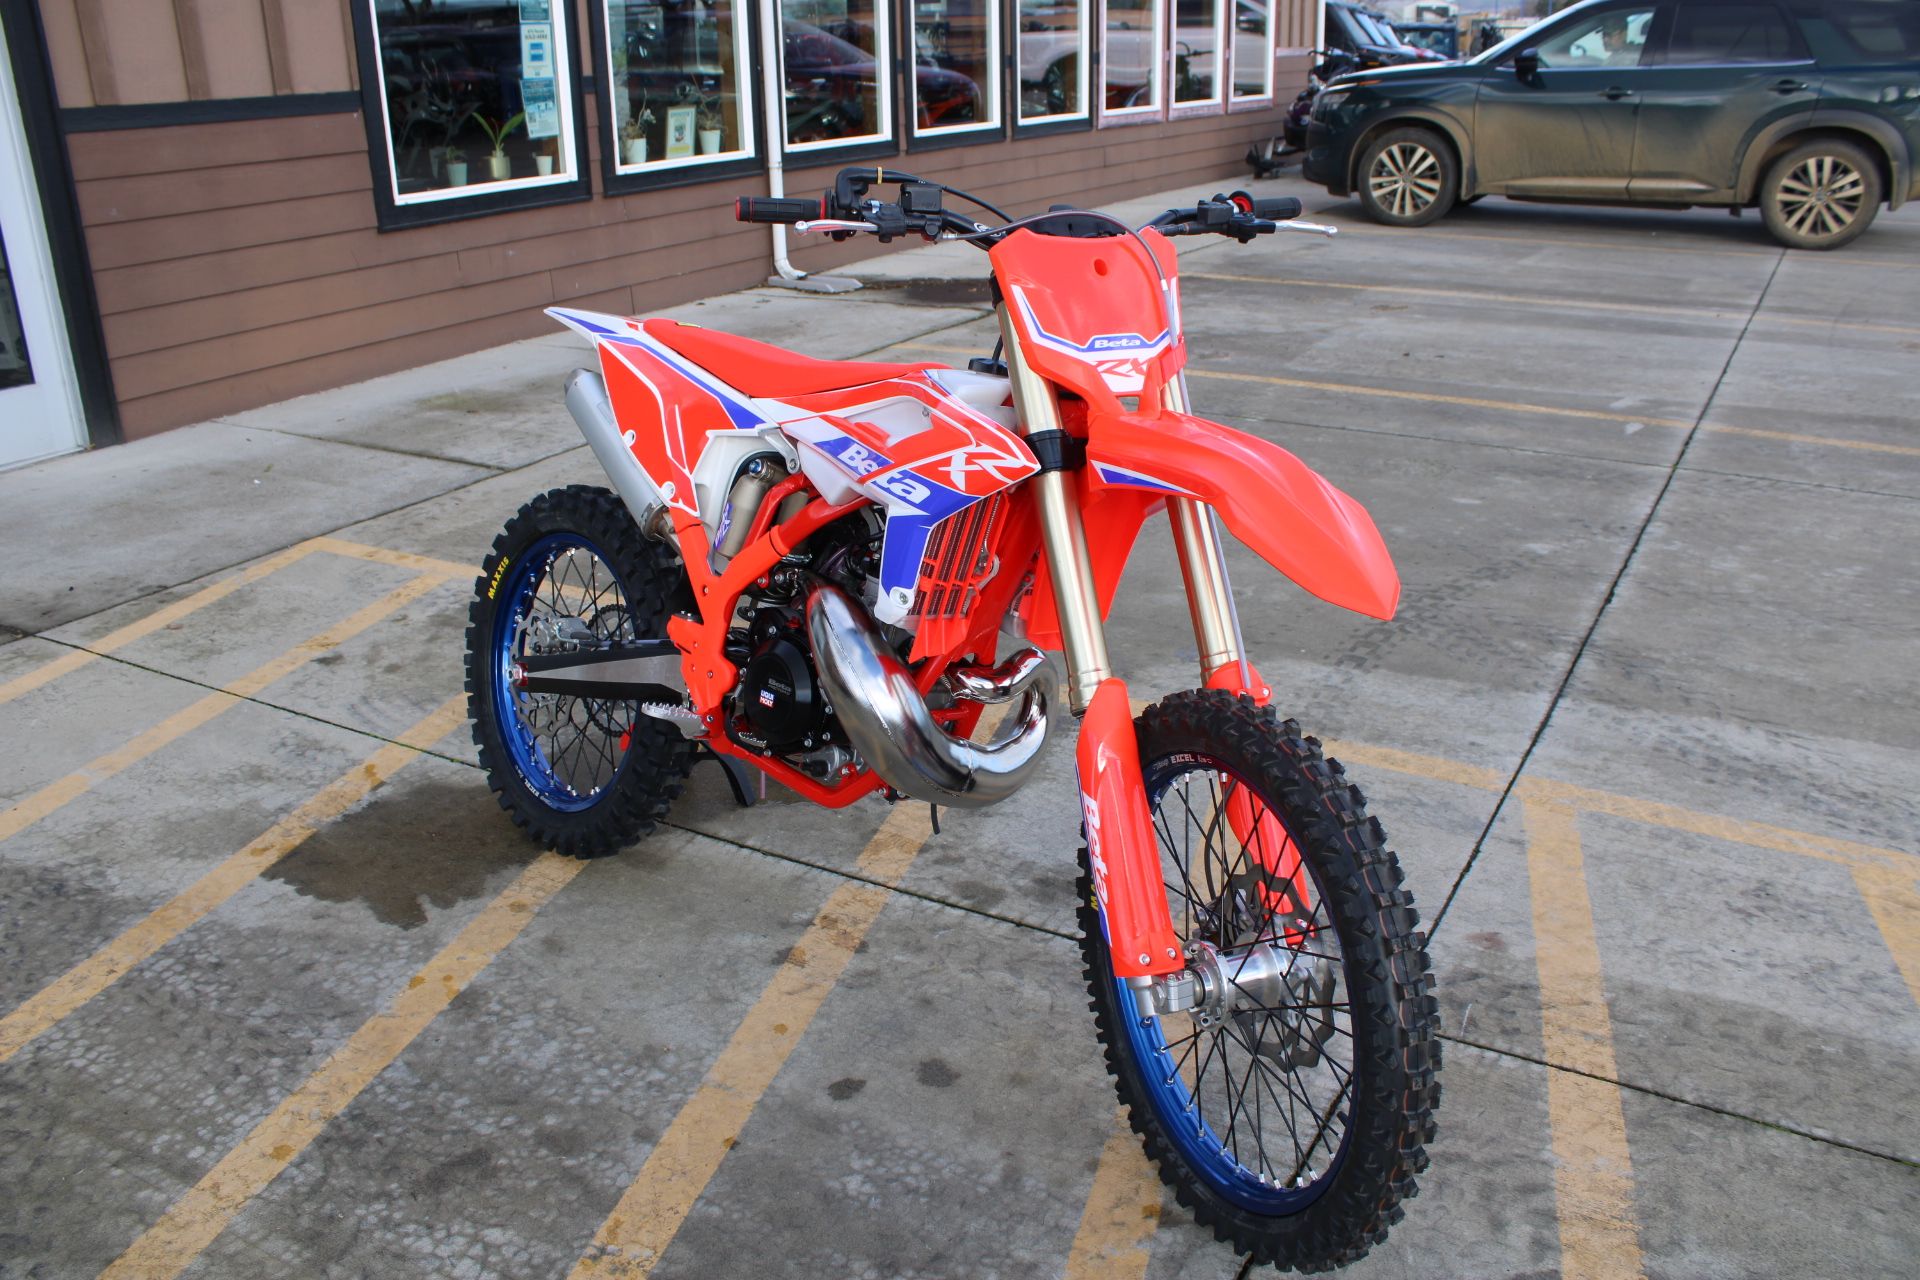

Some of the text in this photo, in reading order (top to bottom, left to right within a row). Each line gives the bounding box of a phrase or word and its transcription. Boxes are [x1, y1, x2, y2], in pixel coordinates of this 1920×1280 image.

[1094, 338, 1141, 349] Beta
[837, 442, 932, 504] Beta
[487, 556, 510, 600] MAXXIS
[759, 696, 774, 708] MOLY
[1171, 753, 1195, 764] EXCEL
[1082, 791, 1109, 905] Beta
